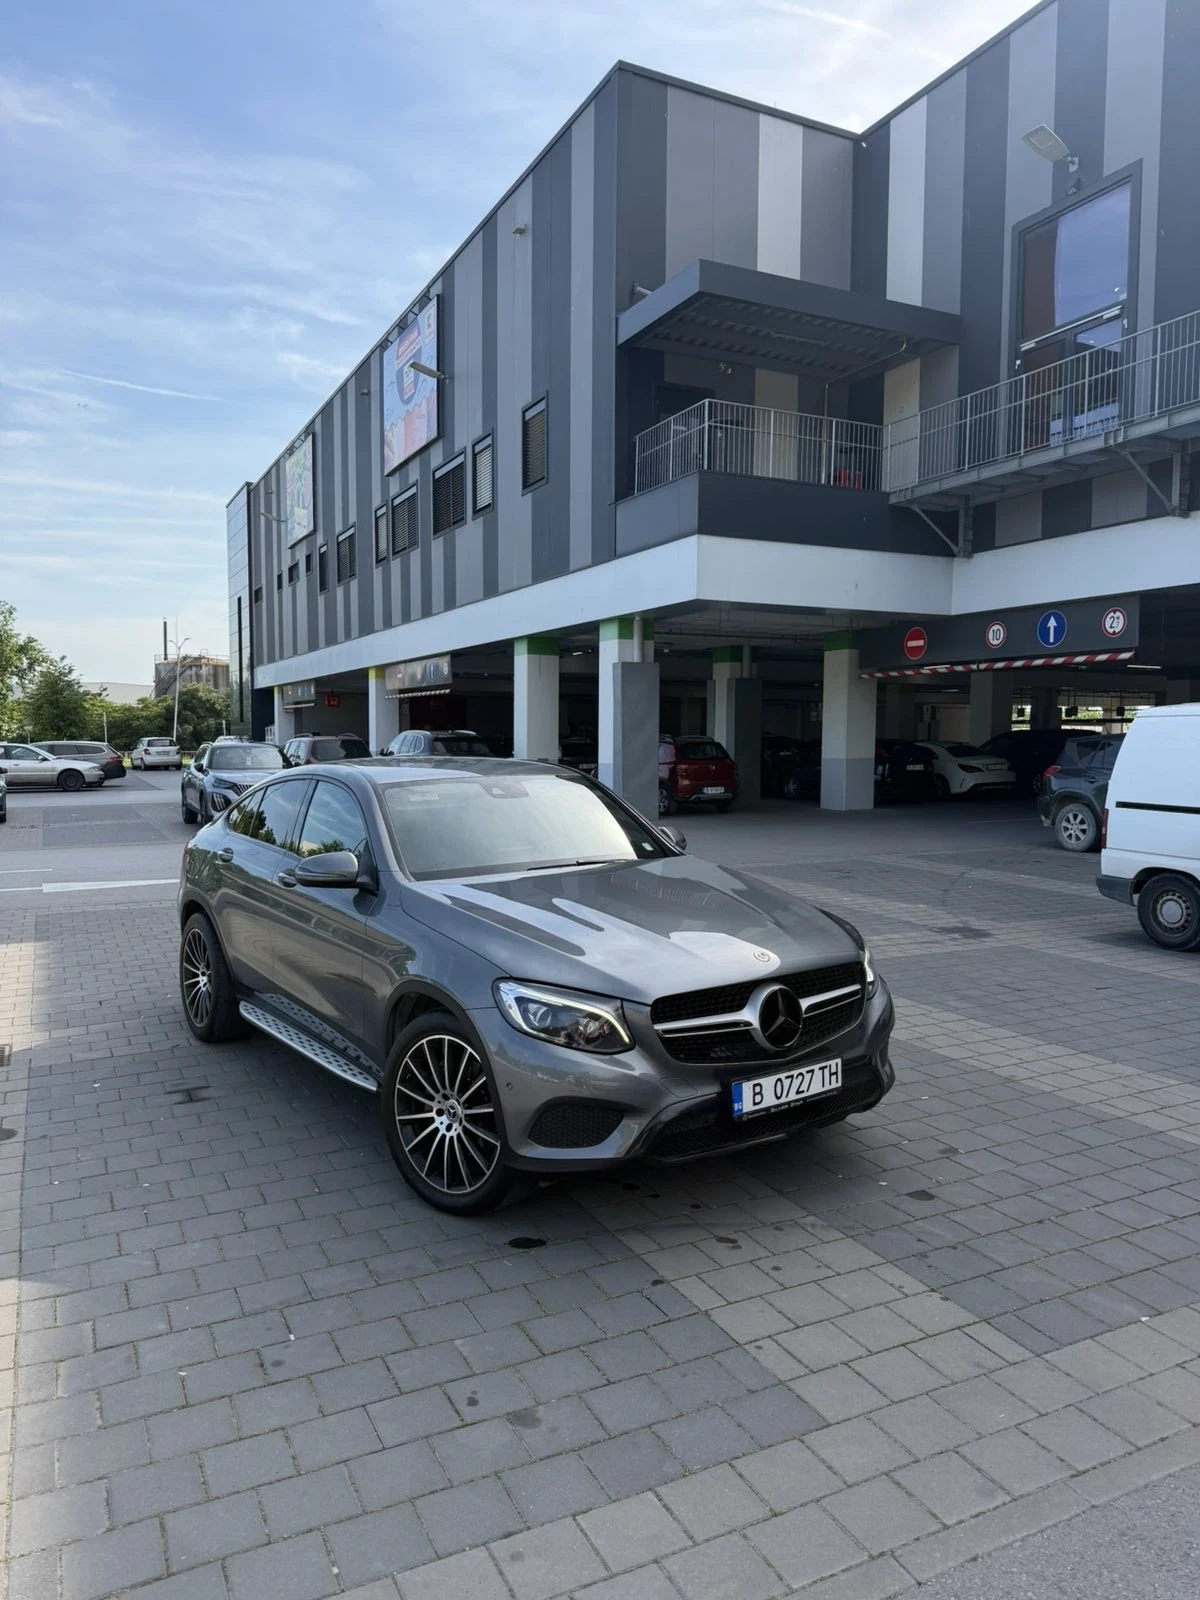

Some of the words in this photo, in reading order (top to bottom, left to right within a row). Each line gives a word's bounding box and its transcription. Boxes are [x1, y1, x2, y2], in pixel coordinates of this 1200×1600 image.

[992, 628, 1001, 641] 10
[752, 1082, 764, 1106] B
[774, 1069, 815, 1100] 0727
[819, 1062, 839, 1088] TH
